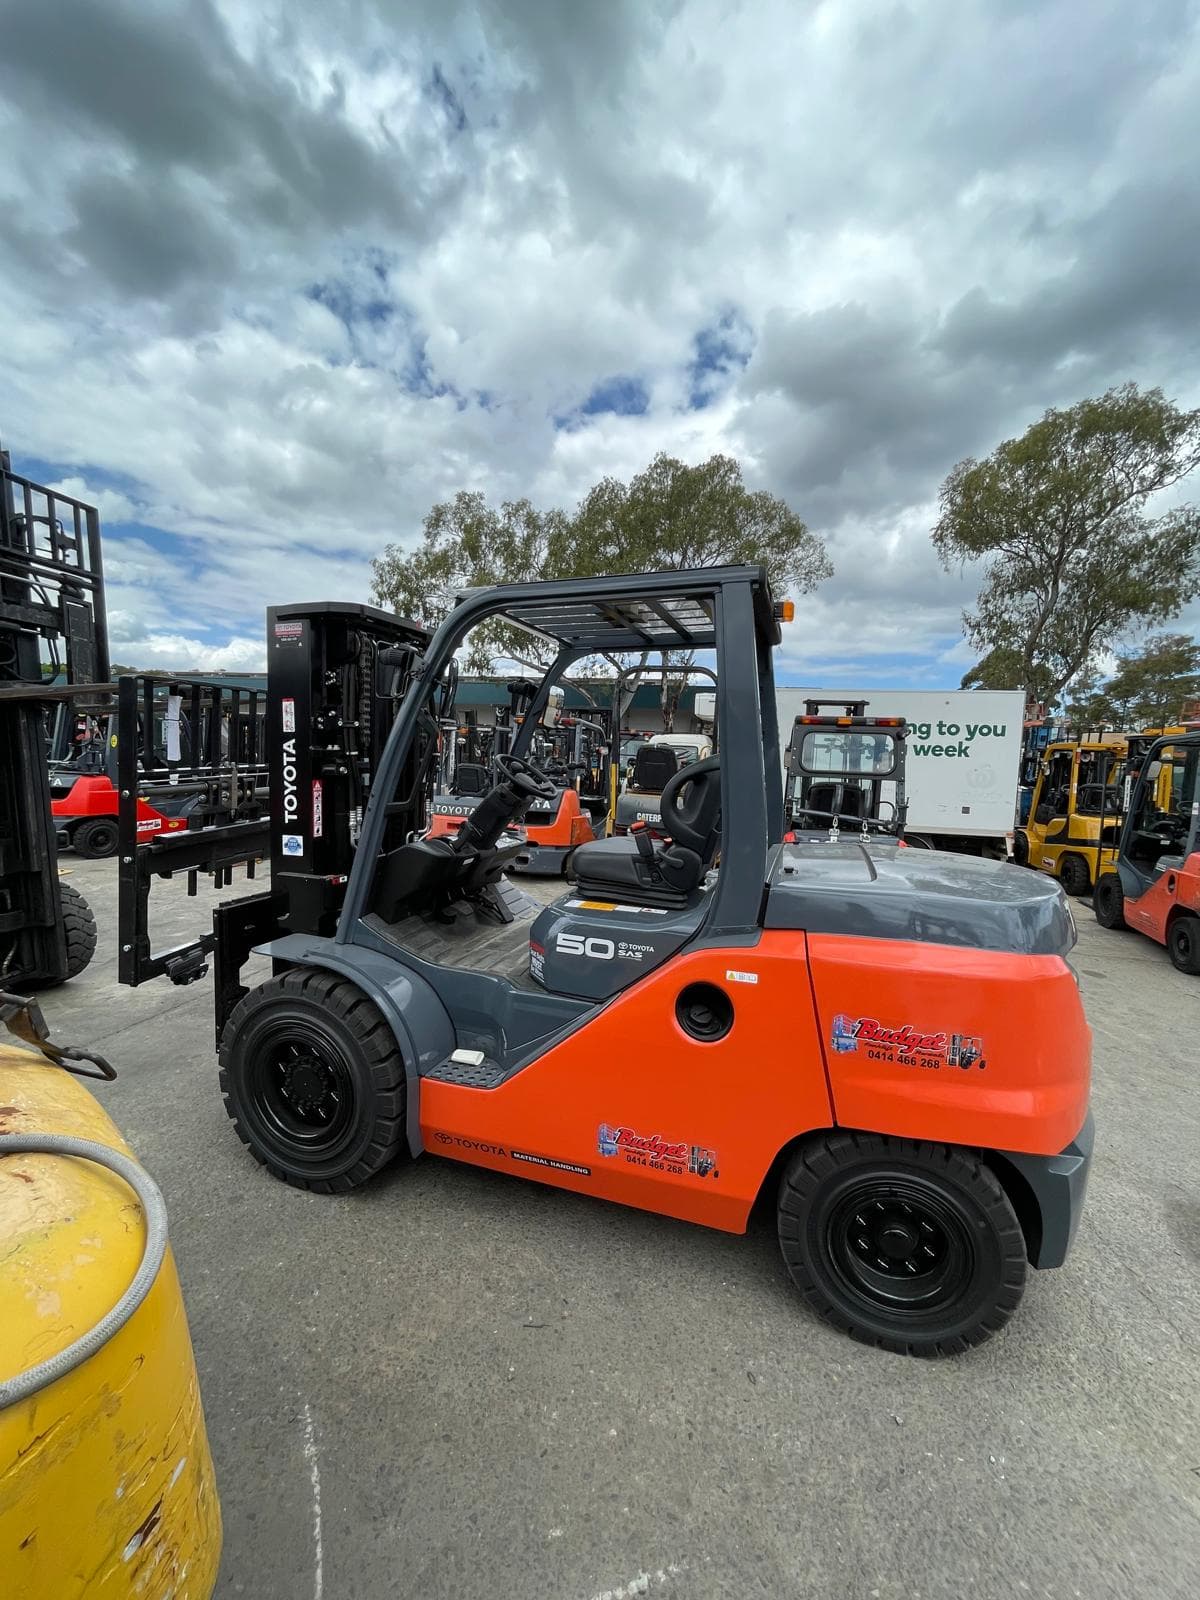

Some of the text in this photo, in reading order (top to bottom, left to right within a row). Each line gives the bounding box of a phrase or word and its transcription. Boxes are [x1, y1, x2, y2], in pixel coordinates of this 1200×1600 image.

[937, 721, 960, 736] to
[965, 724, 1006, 741] you
[913, 741, 970, 758] week
[283, 738, 298, 824] TOYOTA
[556, 932, 615, 960] 50
[618, 950, 643, 958] SAS
[629, 944, 655, 952] TOYOTA
[854, 1018, 947, 1054] Budget
[868, 1050, 940, 1069] 0414 466 268
[454, 1137, 507, 1157] TOYOTA
[615, 1127, 687, 1160] Budget
[513, 1153, 588, 1174] MATERIAL HANDLING
[626, 1155, 647, 1166] 0414
[649, 1160, 665, 1170] 466
[667, 1164, 683, 1175] 268
